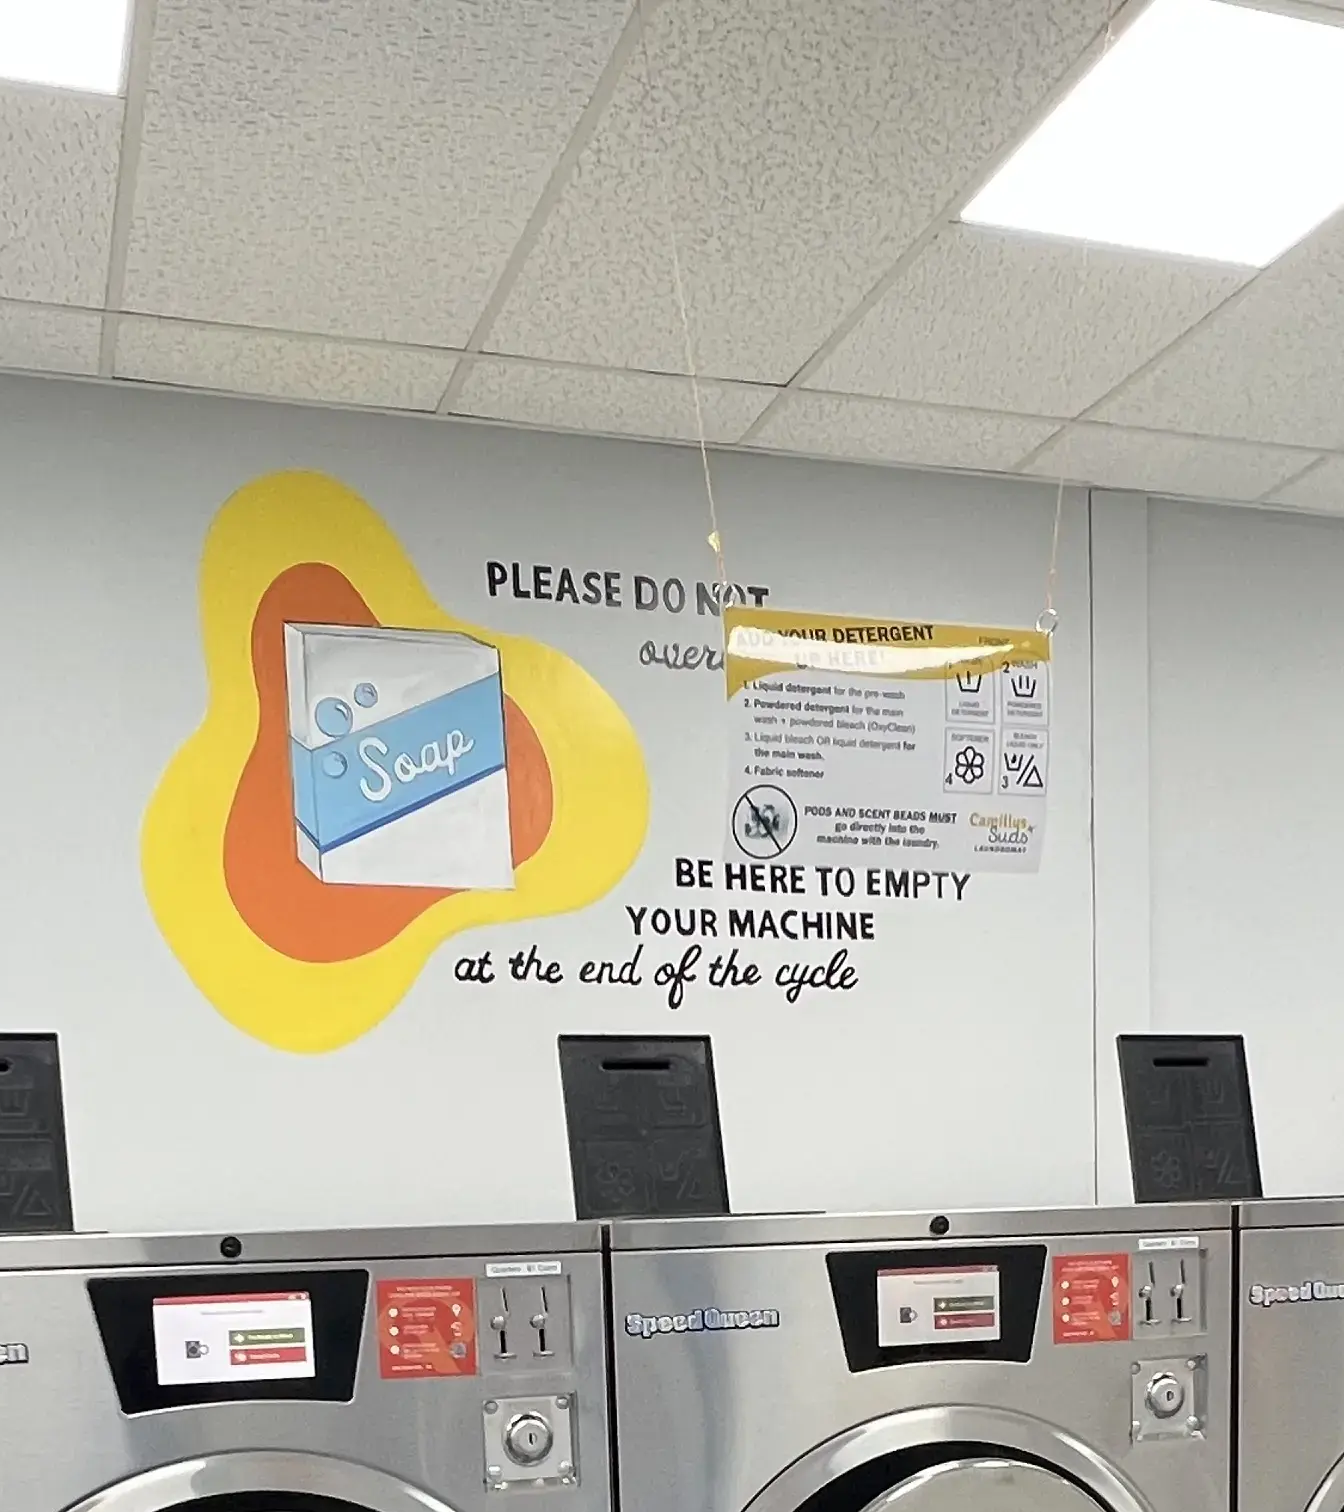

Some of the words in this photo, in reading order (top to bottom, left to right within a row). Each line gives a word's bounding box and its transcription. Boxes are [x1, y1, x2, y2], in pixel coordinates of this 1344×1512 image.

[486, 561, 622, 608] PLEASE
[633, 576, 685, 613] DO
[696, 581, 770, 616] NOT
[832, 625, 934, 644] DETERGENT
[639, 640, 725, 671] over
[753, 680, 784, 694] Liquid
[786, 683, 831, 696] detergent
[753, 699, 802, 711] Powdered
[804, 702, 849, 715] detergent
[754, 732, 783, 744] Liquid
[754, 748, 770, 758] the
[358, 729, 475, 802] Soap
[754, 765, 784, 777] Fabric
[786, 768, 825, 779] softener
[944, 772, 953, 785] 4
[1001, 775, 1009, 789] 3
[804, 805, 832, 817] PODS
[834, 807, 856, 818] AND
[858, 808, 891, 819] SCENT
[893, 810, 926, 822] BEADS
[928, 812, 958, 824] MUST
[850, 820, 887, 835] directly
[988, 825, 1029, 845] Suds
[675, 857, 714, 889] BE
[725, 862, 806, 895] HERE
[815, 866, 856, 898] TO
[866, 868, 971, 901] EMPTY
[625, 905, 718, 938] YOUR
[728, 908, 875, 941] MACHINE
[454, 951, 496, 984] at
[509, 945, 564, 983] the
[579, 944, 643, 986] end
[654, 943, 702, 1010] of
[709, 948, 762, 987] the
[775, 949, 859, 1004] cycle
